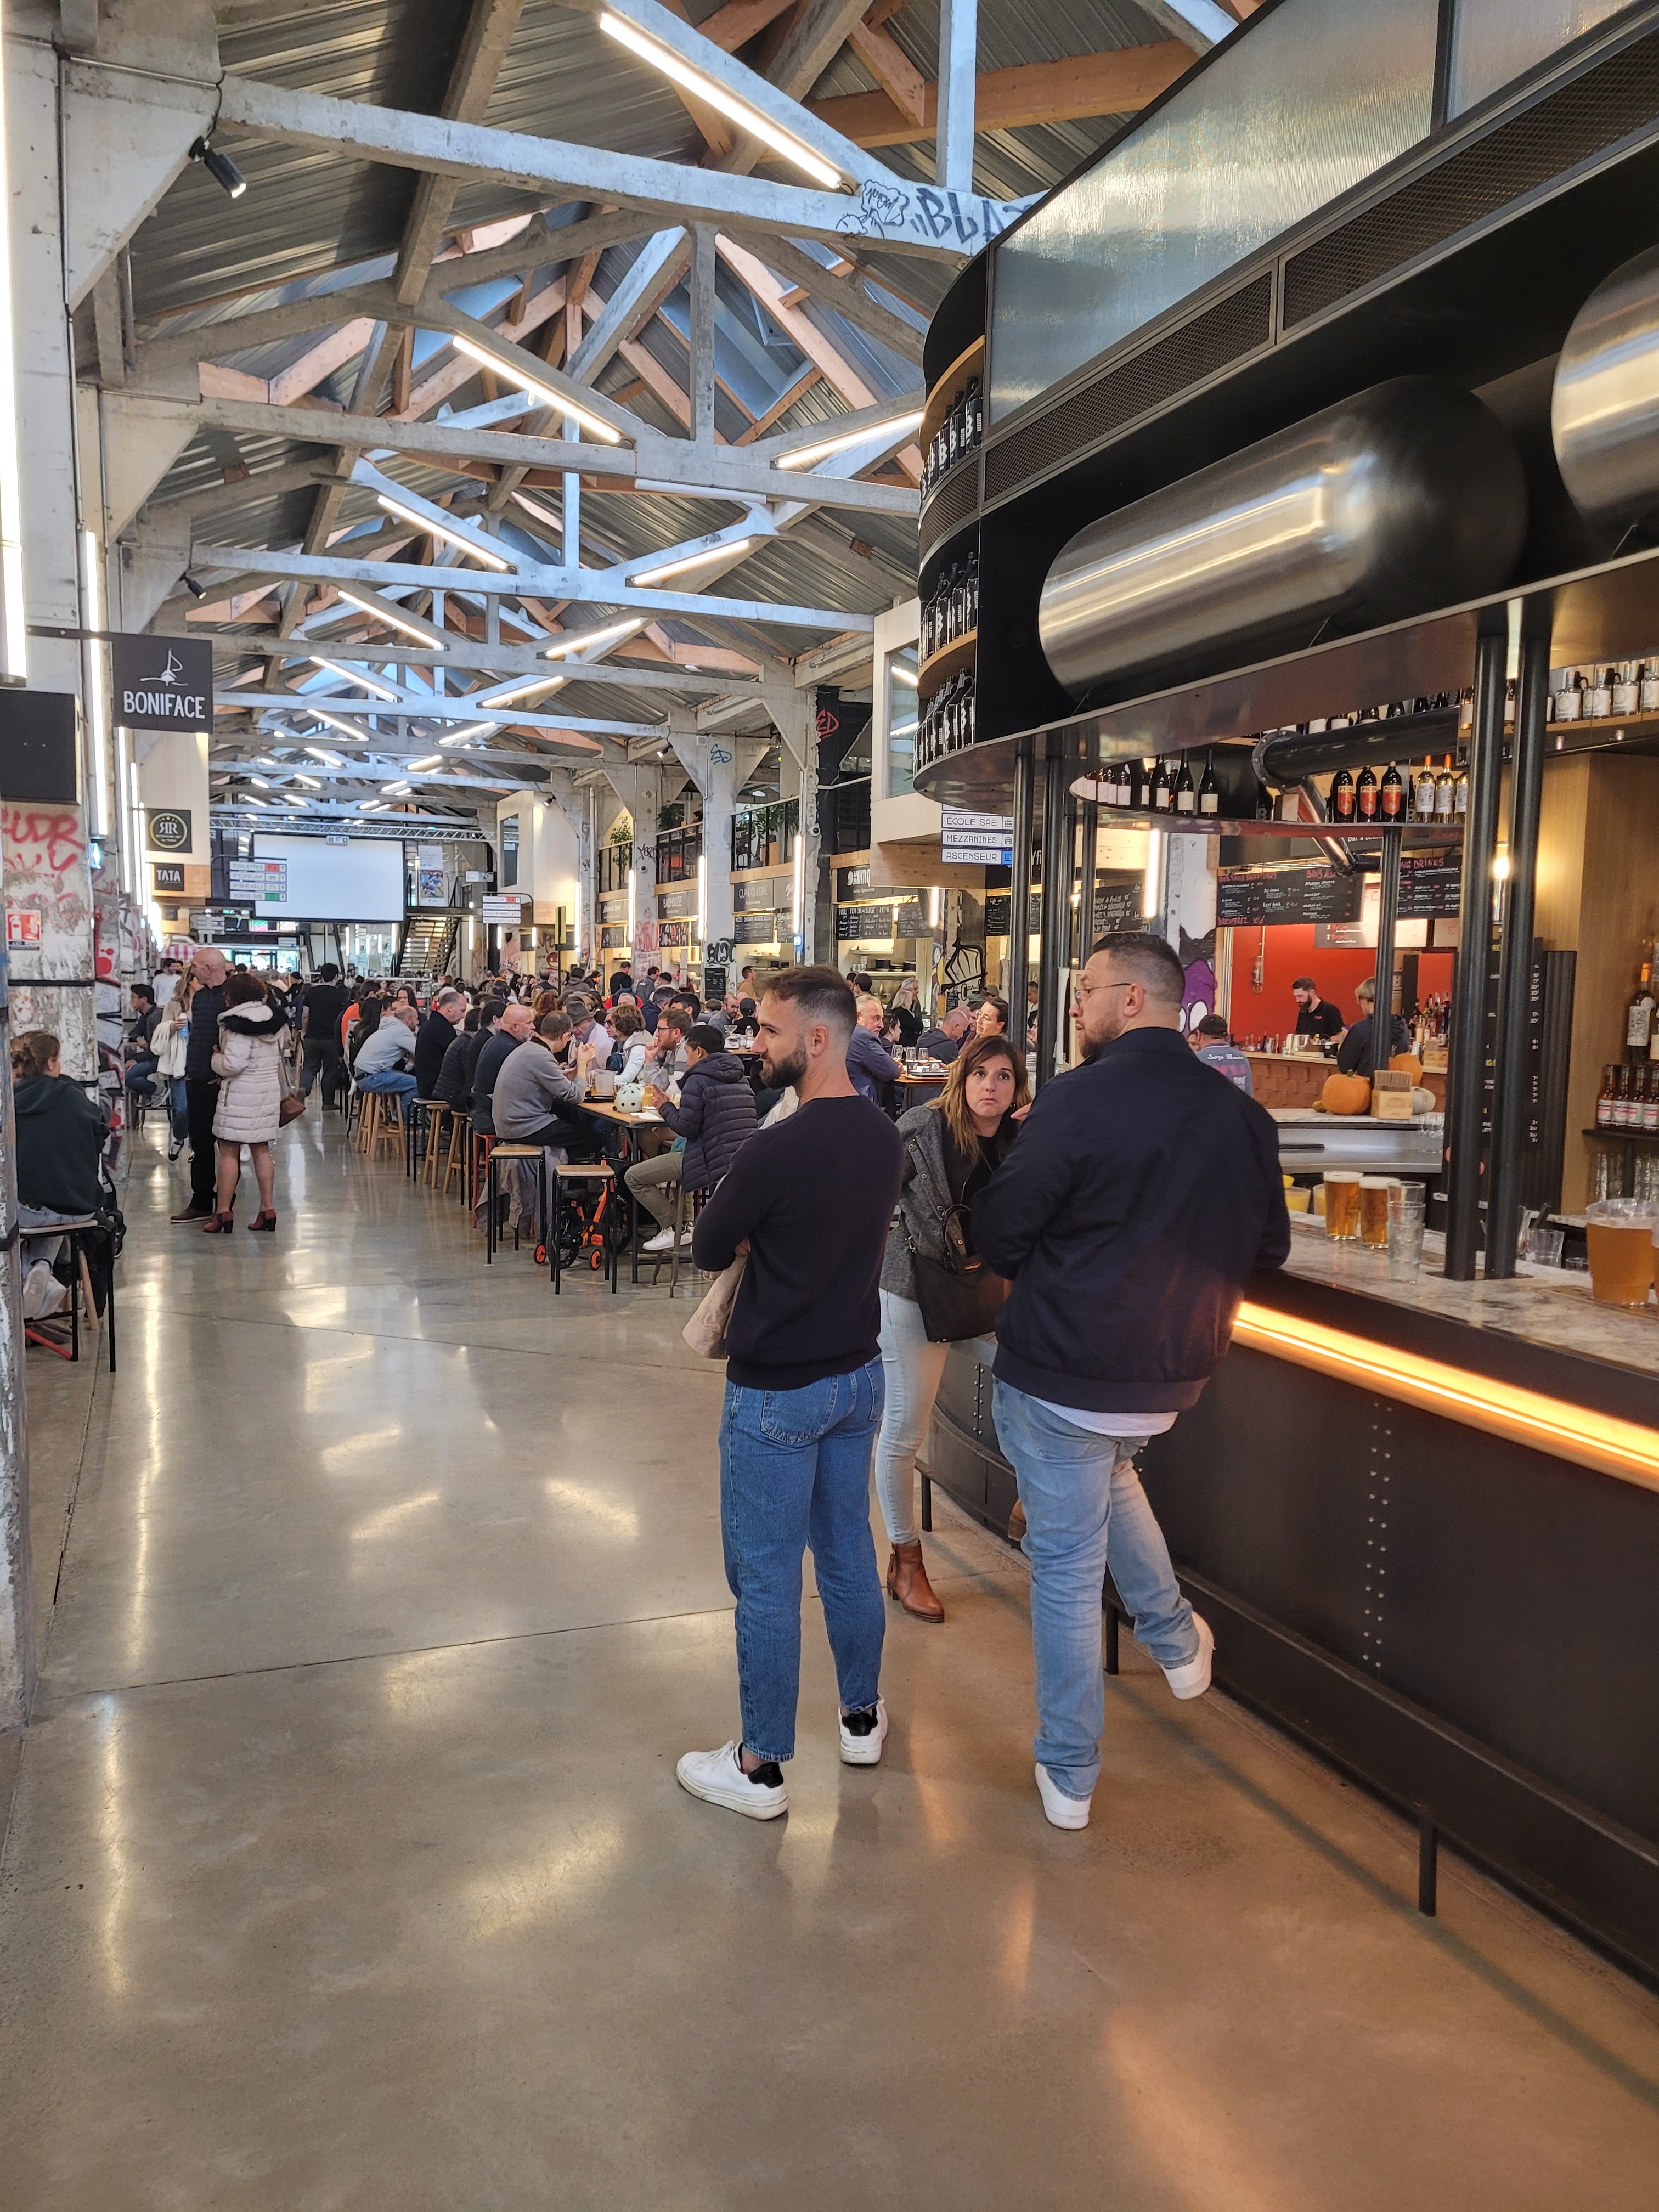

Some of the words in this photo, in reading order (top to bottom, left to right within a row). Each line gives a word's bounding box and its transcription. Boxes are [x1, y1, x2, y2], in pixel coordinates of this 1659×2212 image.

[123, 690, 205, 719] BONIFACE
[946, 815, 976, 825] ÉCOLE
[979, 819, 997, 827] SAE
[946, 835, 997, 844] MEZZANINES
[946, 852, 997, 861] ASCENSEUR
[156, 869, 180, 881] TATA
